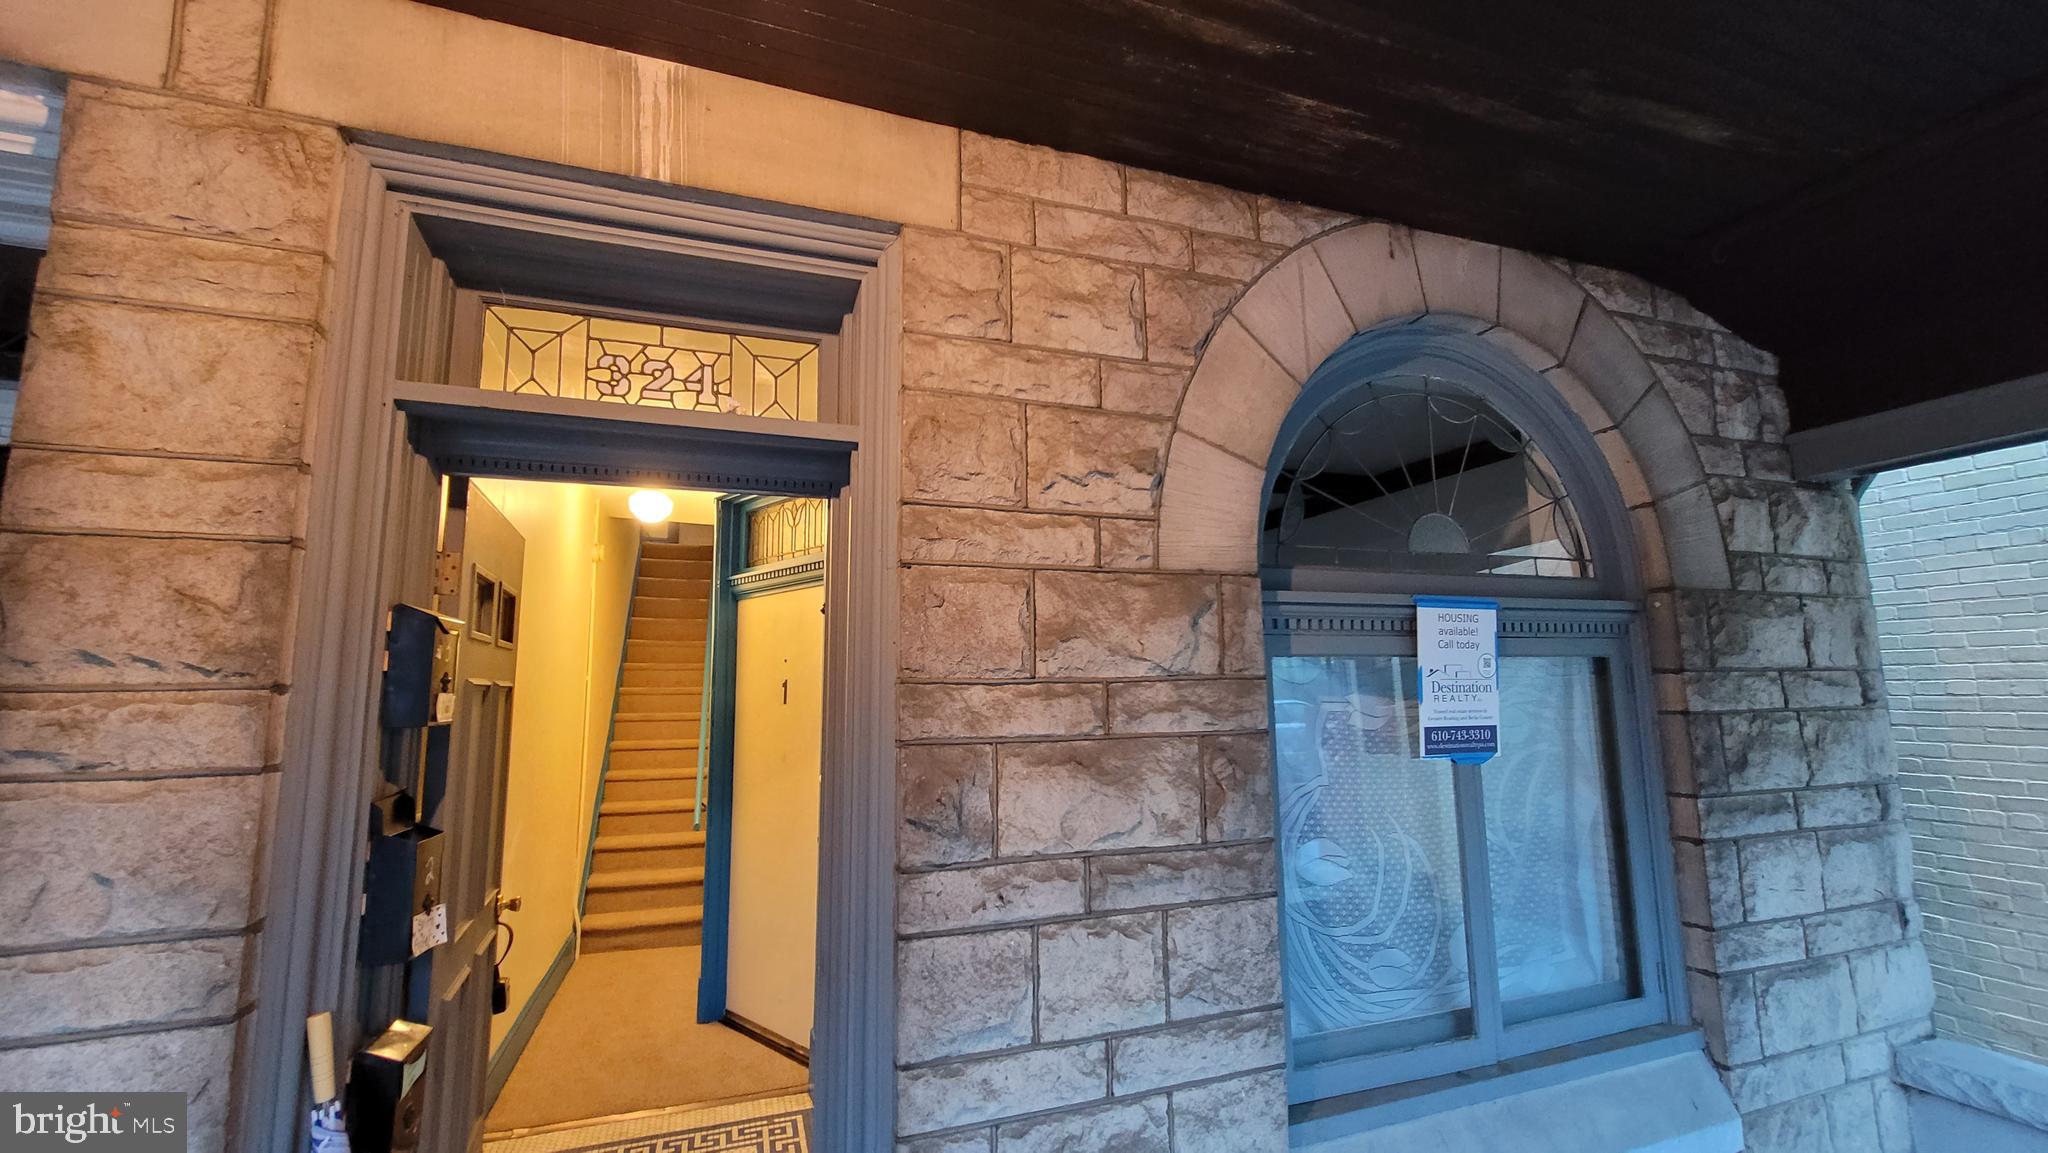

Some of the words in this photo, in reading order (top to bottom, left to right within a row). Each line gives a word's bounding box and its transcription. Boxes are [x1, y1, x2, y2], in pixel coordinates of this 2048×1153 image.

[596, 353, 720, 407] 324
[1437, 613, 1480, 624] HOUSING
[1437, 626, 1479, 637] available!
[1437, 639, 1454, 649] Call
[1456, 639, 1481, 651] today
[781, 679, 788, 705] 1
[1431, 680, 1493, 694] Destination
[1433, 694, 1479, 703] REALTY
[1431, 729, 1491, 742] 610-743-3310
